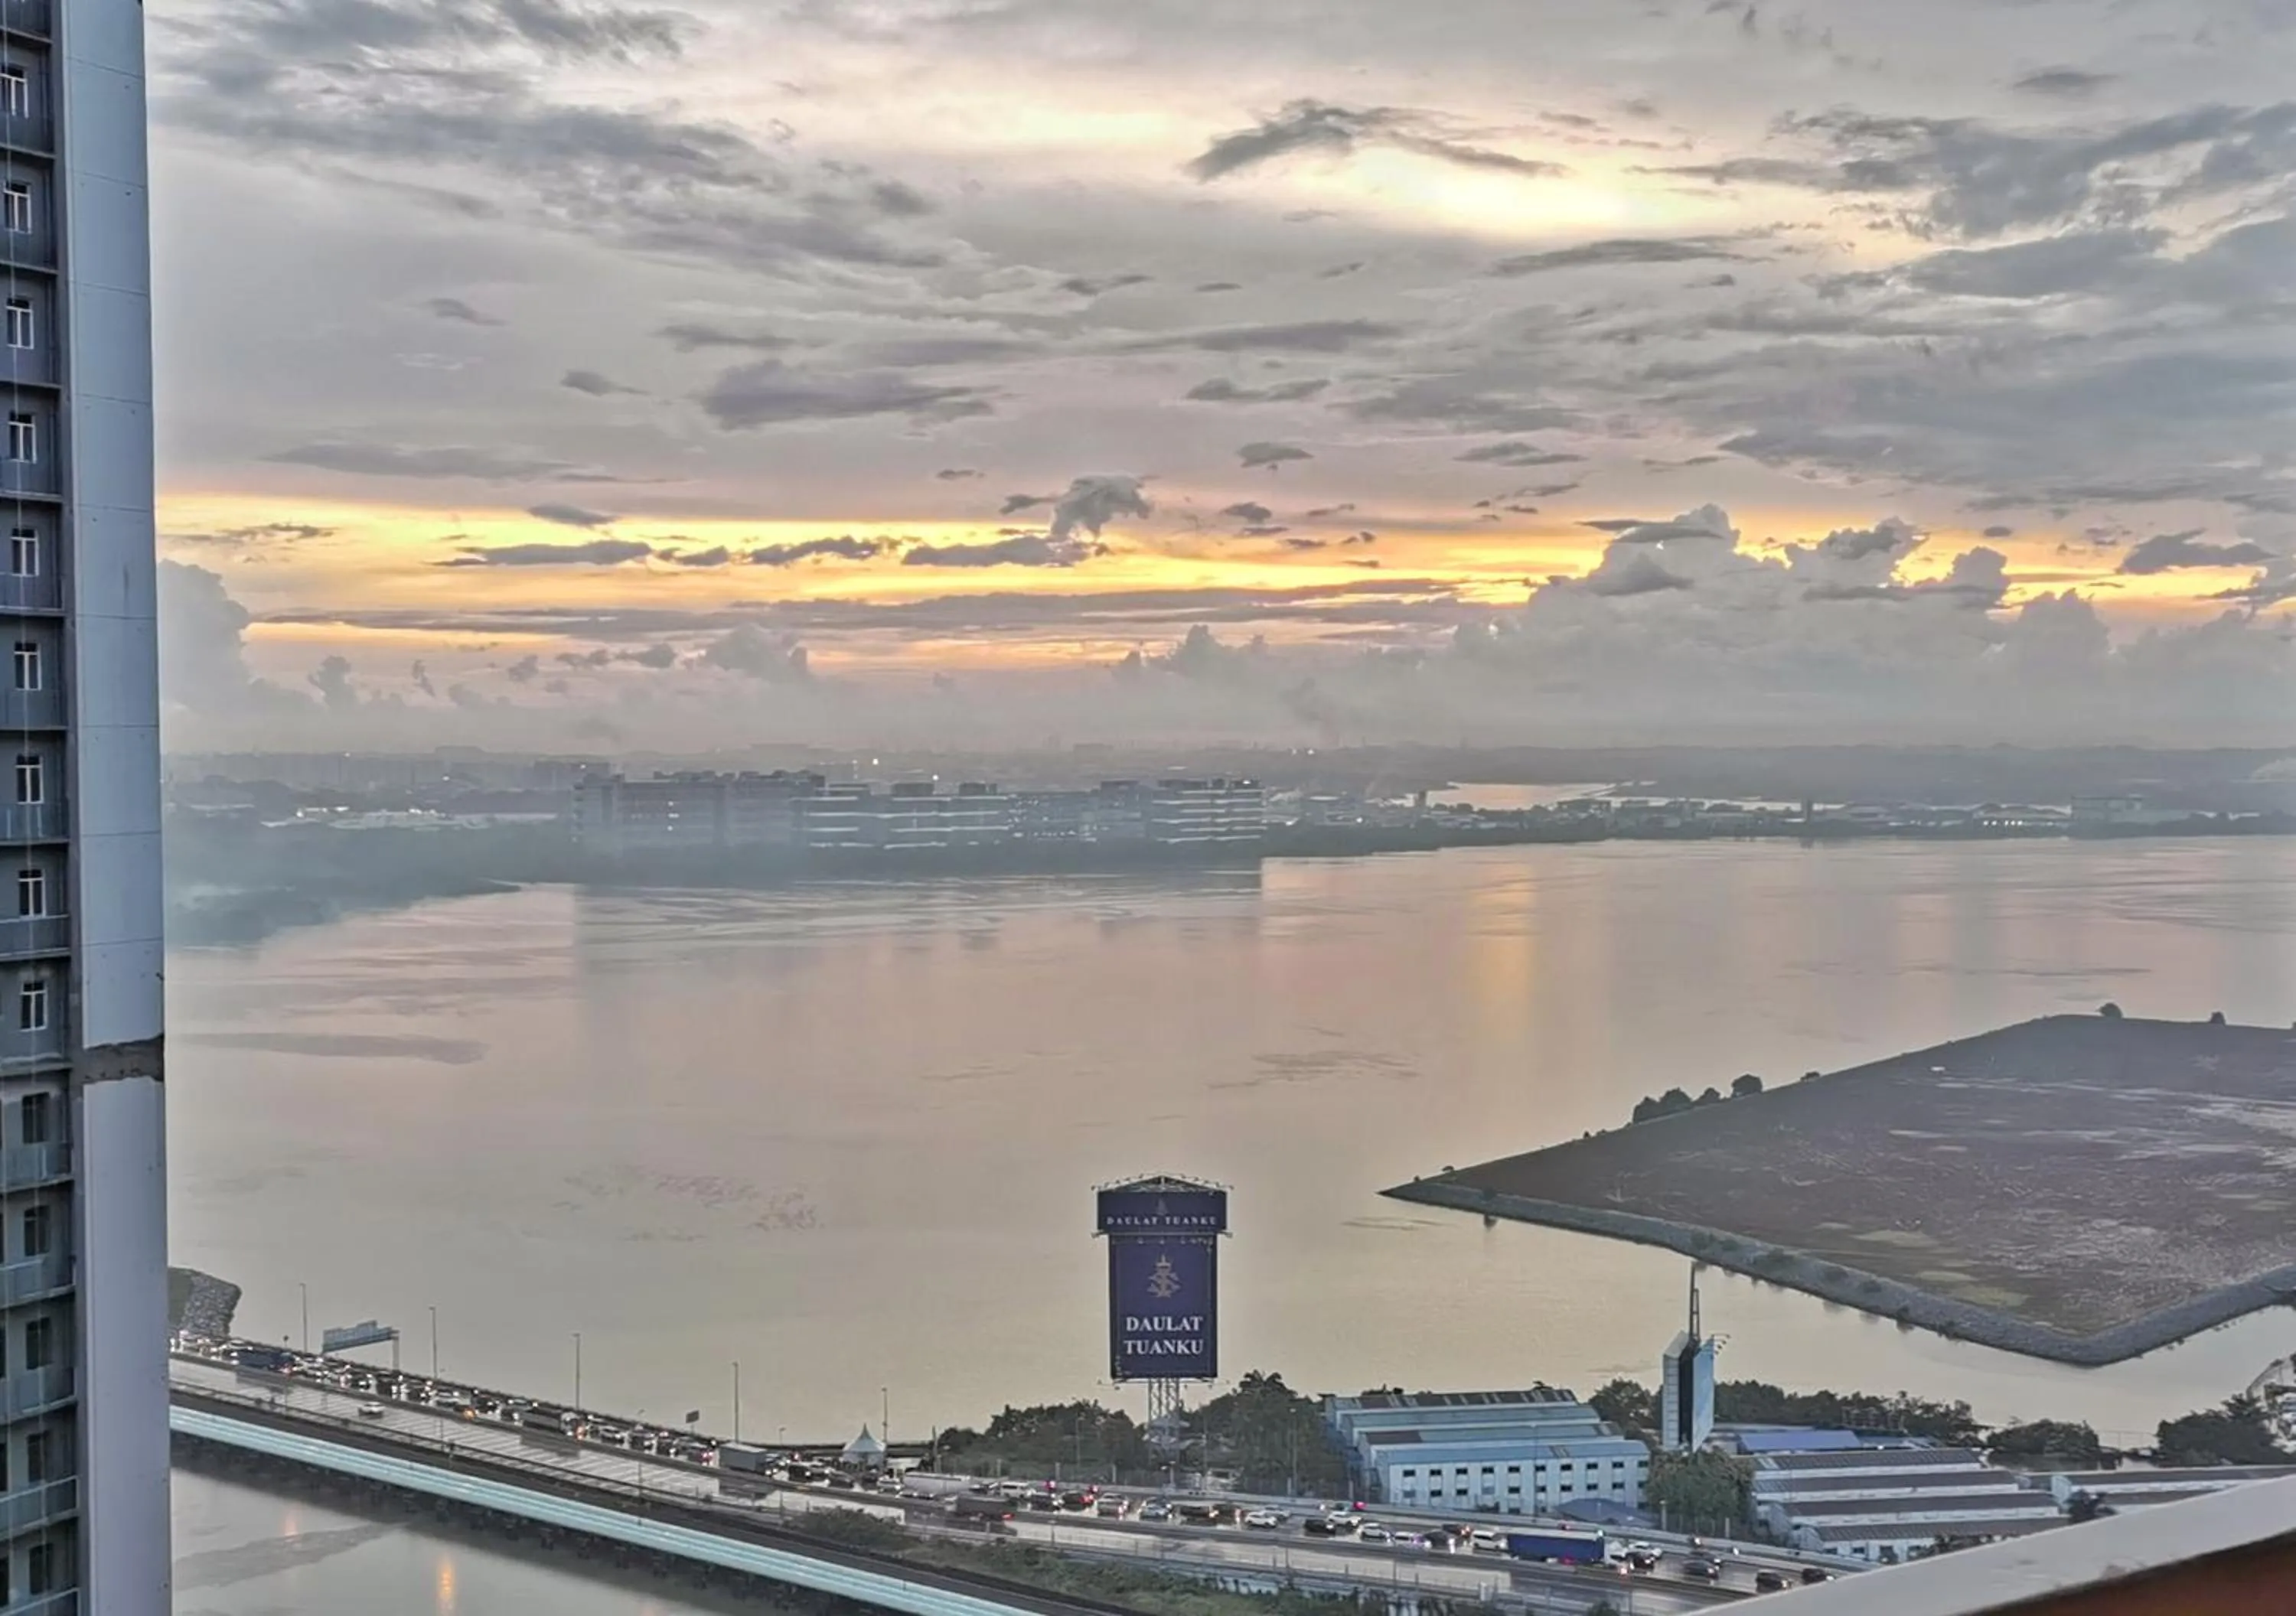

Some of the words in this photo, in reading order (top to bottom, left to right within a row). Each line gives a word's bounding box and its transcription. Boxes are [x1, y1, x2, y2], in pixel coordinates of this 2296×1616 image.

[1107, 1216, 1158, 1225] DAULAT
[1126, 1316, 1203, 1331] DAULAT
[1124, 1340, 1203, 1355] TUANKU
